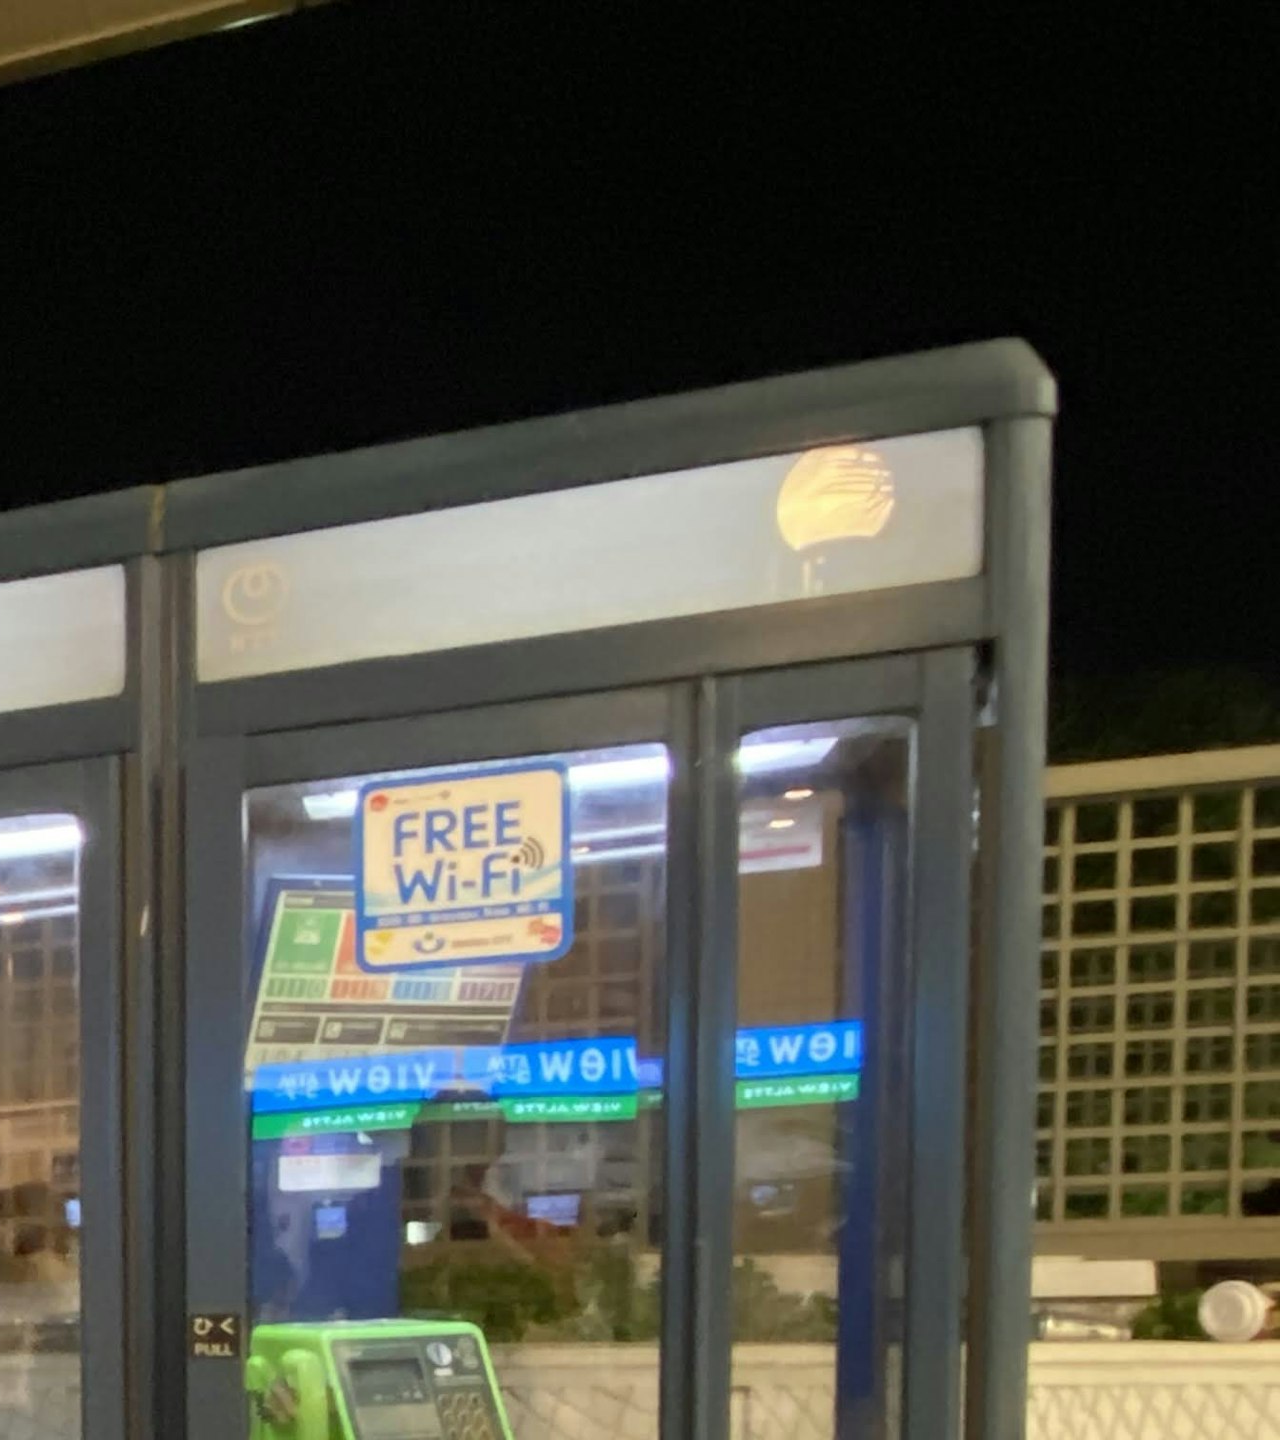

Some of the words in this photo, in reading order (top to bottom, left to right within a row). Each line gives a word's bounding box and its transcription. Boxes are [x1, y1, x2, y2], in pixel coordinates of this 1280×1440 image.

[393, 801, 521, 856] FREE
[394, 850, 521, 904] Wi-Fi
[193, 1317, 235, 1335] ひく
[194, 1342, 234, 1357] PULL
